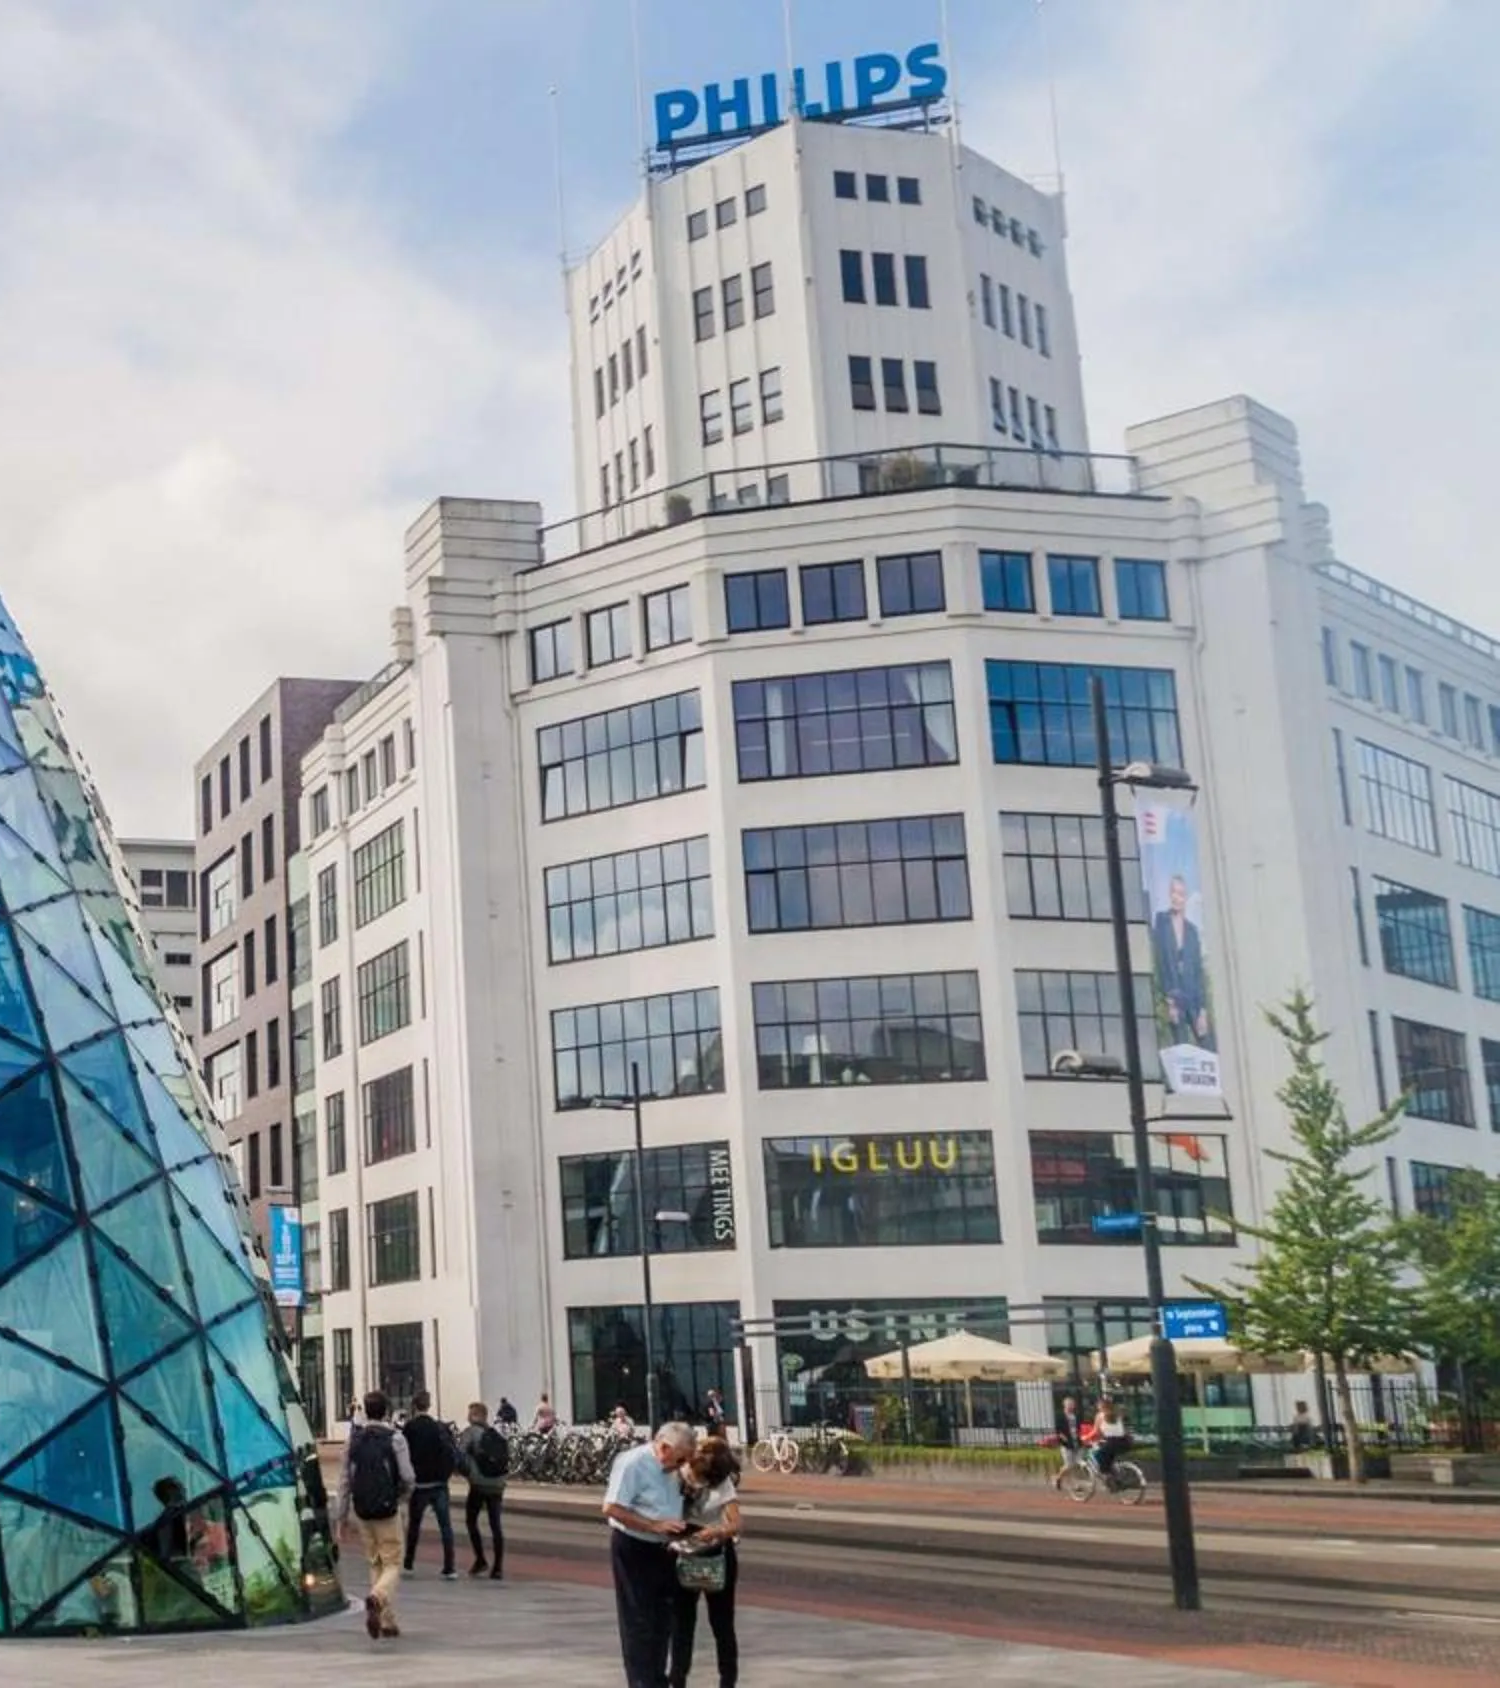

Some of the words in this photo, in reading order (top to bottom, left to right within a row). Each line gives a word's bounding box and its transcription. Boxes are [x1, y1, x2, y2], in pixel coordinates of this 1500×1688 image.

[655, 43, 947, 142] PHILIPS
[708, 1150, 734, 1241] MEETINGS
[811, 1140, 958, 1173] IGLUU
